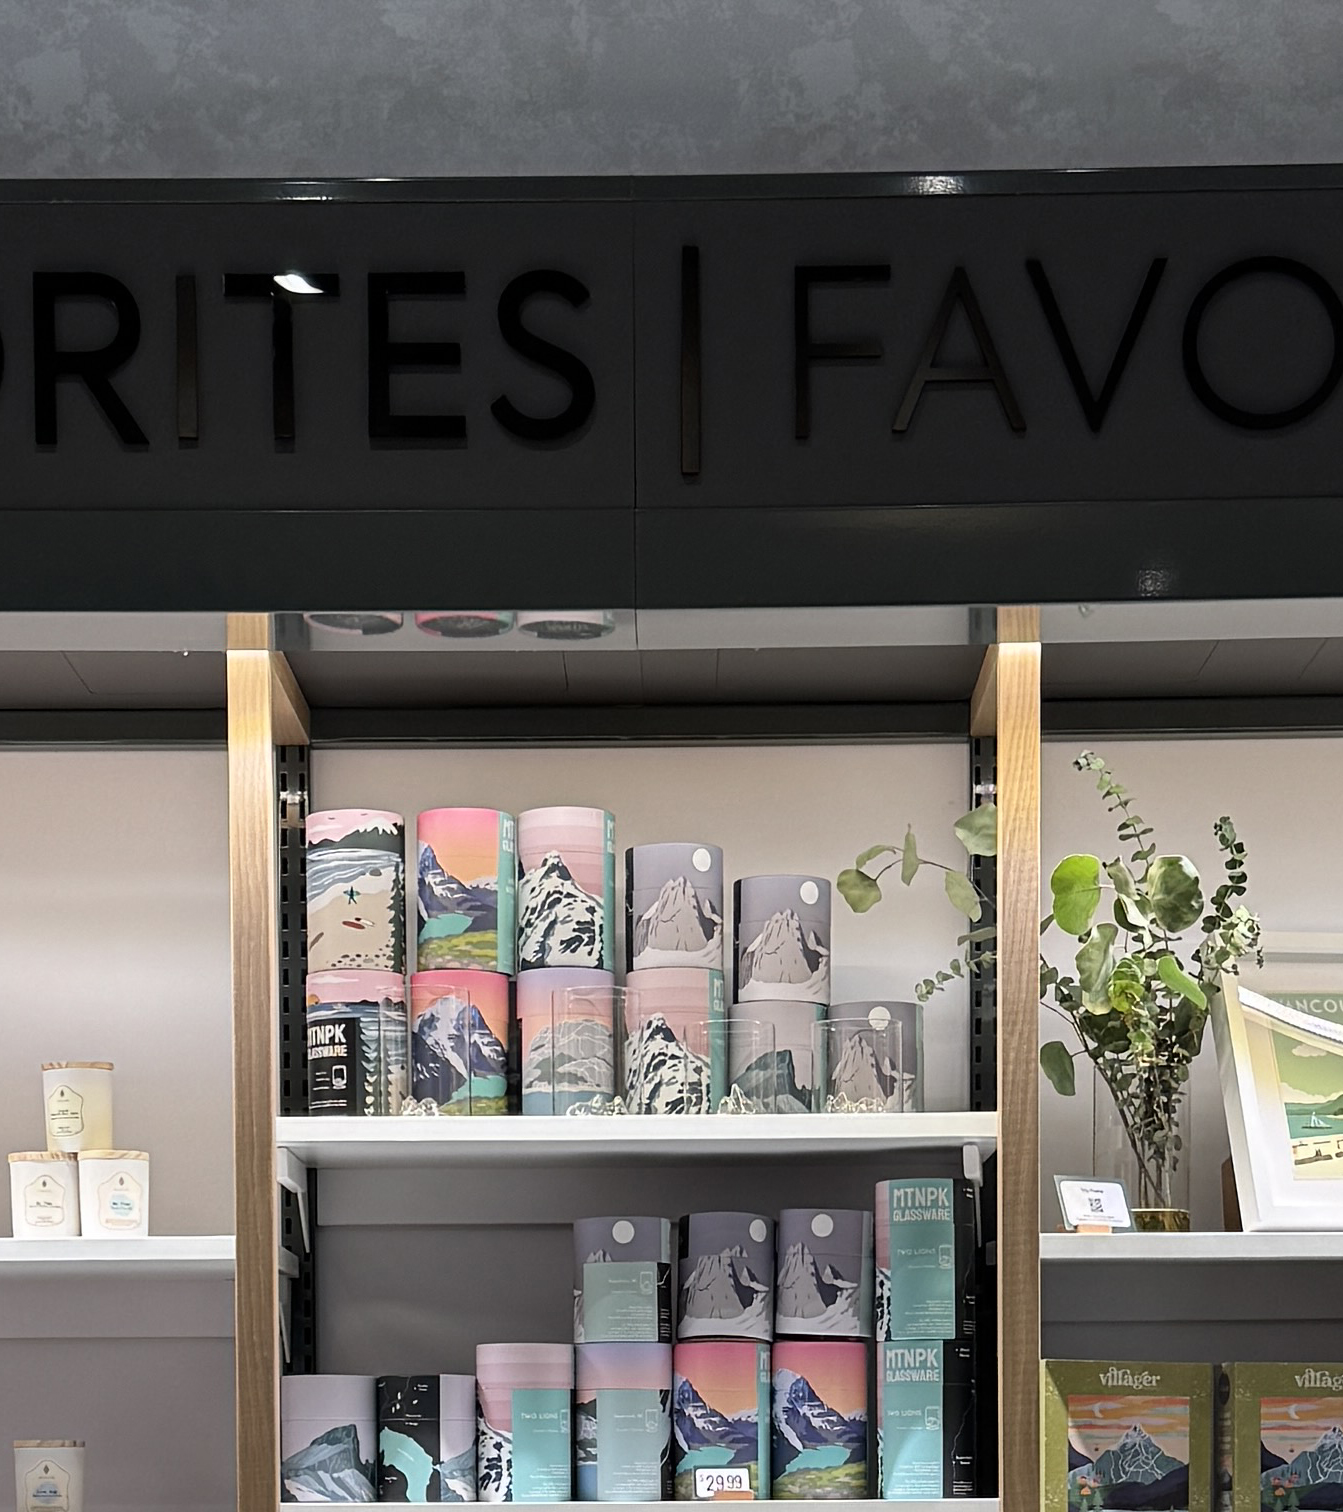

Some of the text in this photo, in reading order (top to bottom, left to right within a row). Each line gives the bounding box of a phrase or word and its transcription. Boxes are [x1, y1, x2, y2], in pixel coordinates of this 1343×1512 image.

[308, 1045, 349, 1061] LASSWARE
[893, 1187, 950, 1209] MTNPK
[893, 1208, 952, 1223] GLASSWARE
[886, 1348, 939, 1370] MTNPK
[886, 1369, 940, 1383] GLASSWARE
[1099, 1367, 1161, 1390] villager
[521, 1413, 537, 1421] TWO
